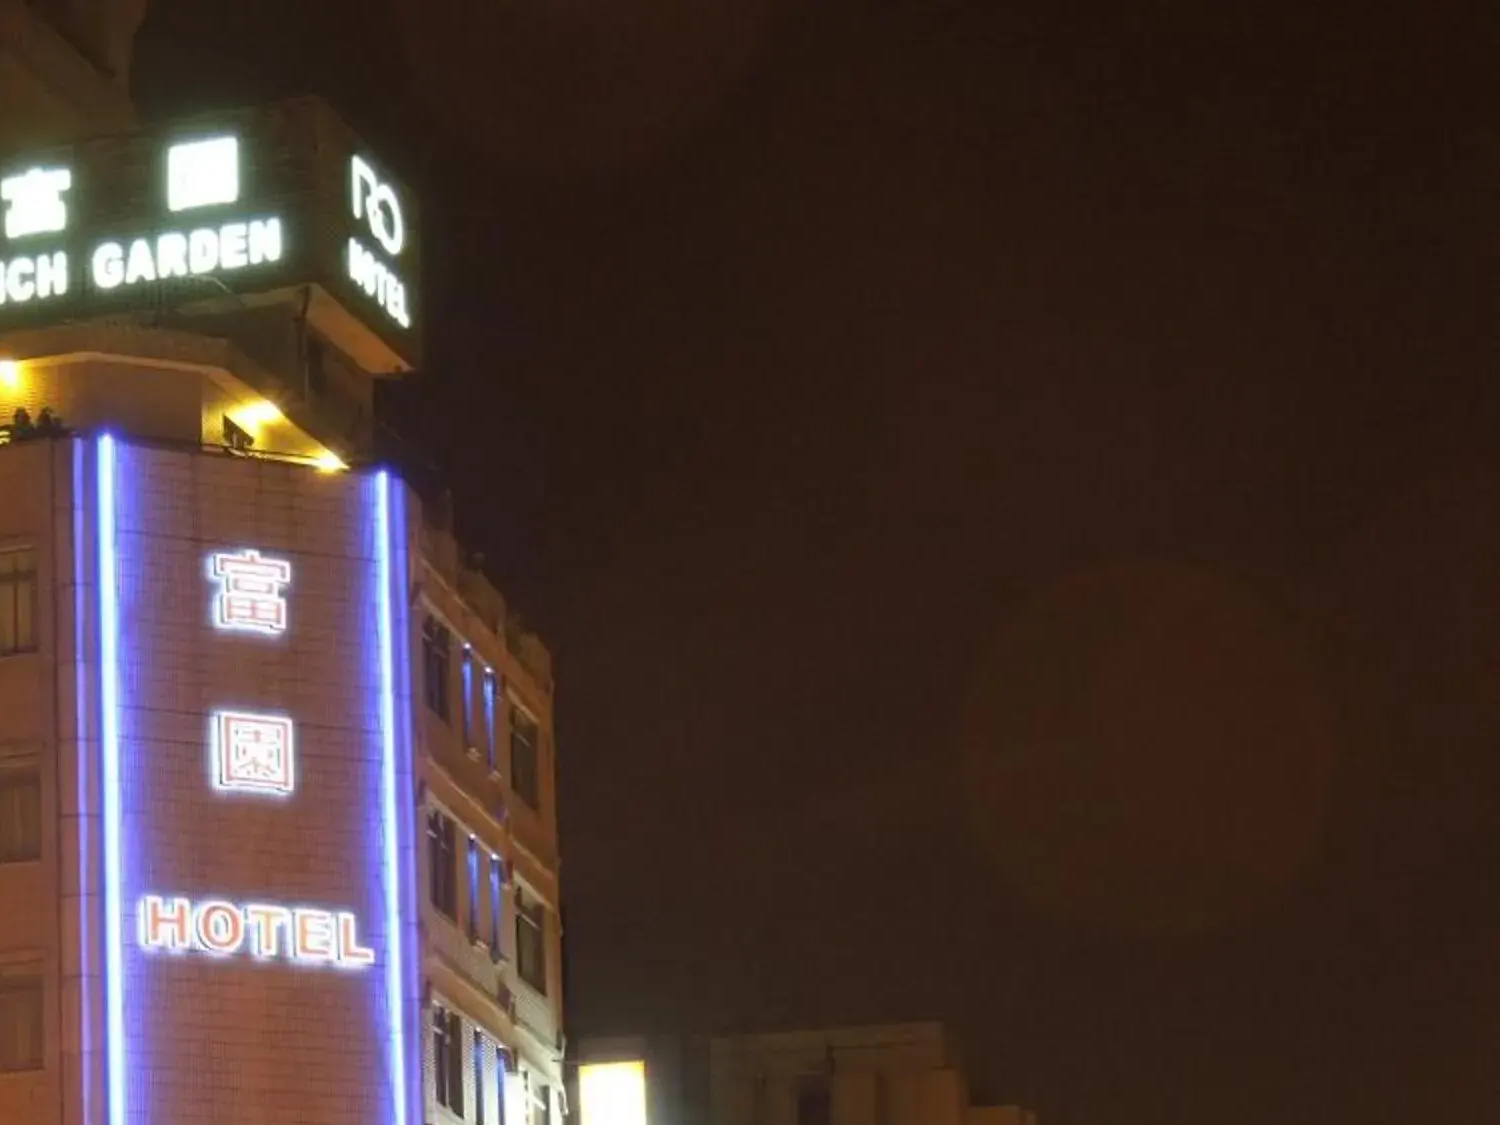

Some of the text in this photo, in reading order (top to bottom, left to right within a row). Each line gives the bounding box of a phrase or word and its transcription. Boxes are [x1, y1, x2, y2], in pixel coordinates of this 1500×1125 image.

[92, 217, 284, 289] GARDEN
[349, 237, 411, 330] HOTEL
[208, 548, 296, 794] 富園
[140, 895, 375, 965] HOTEL
